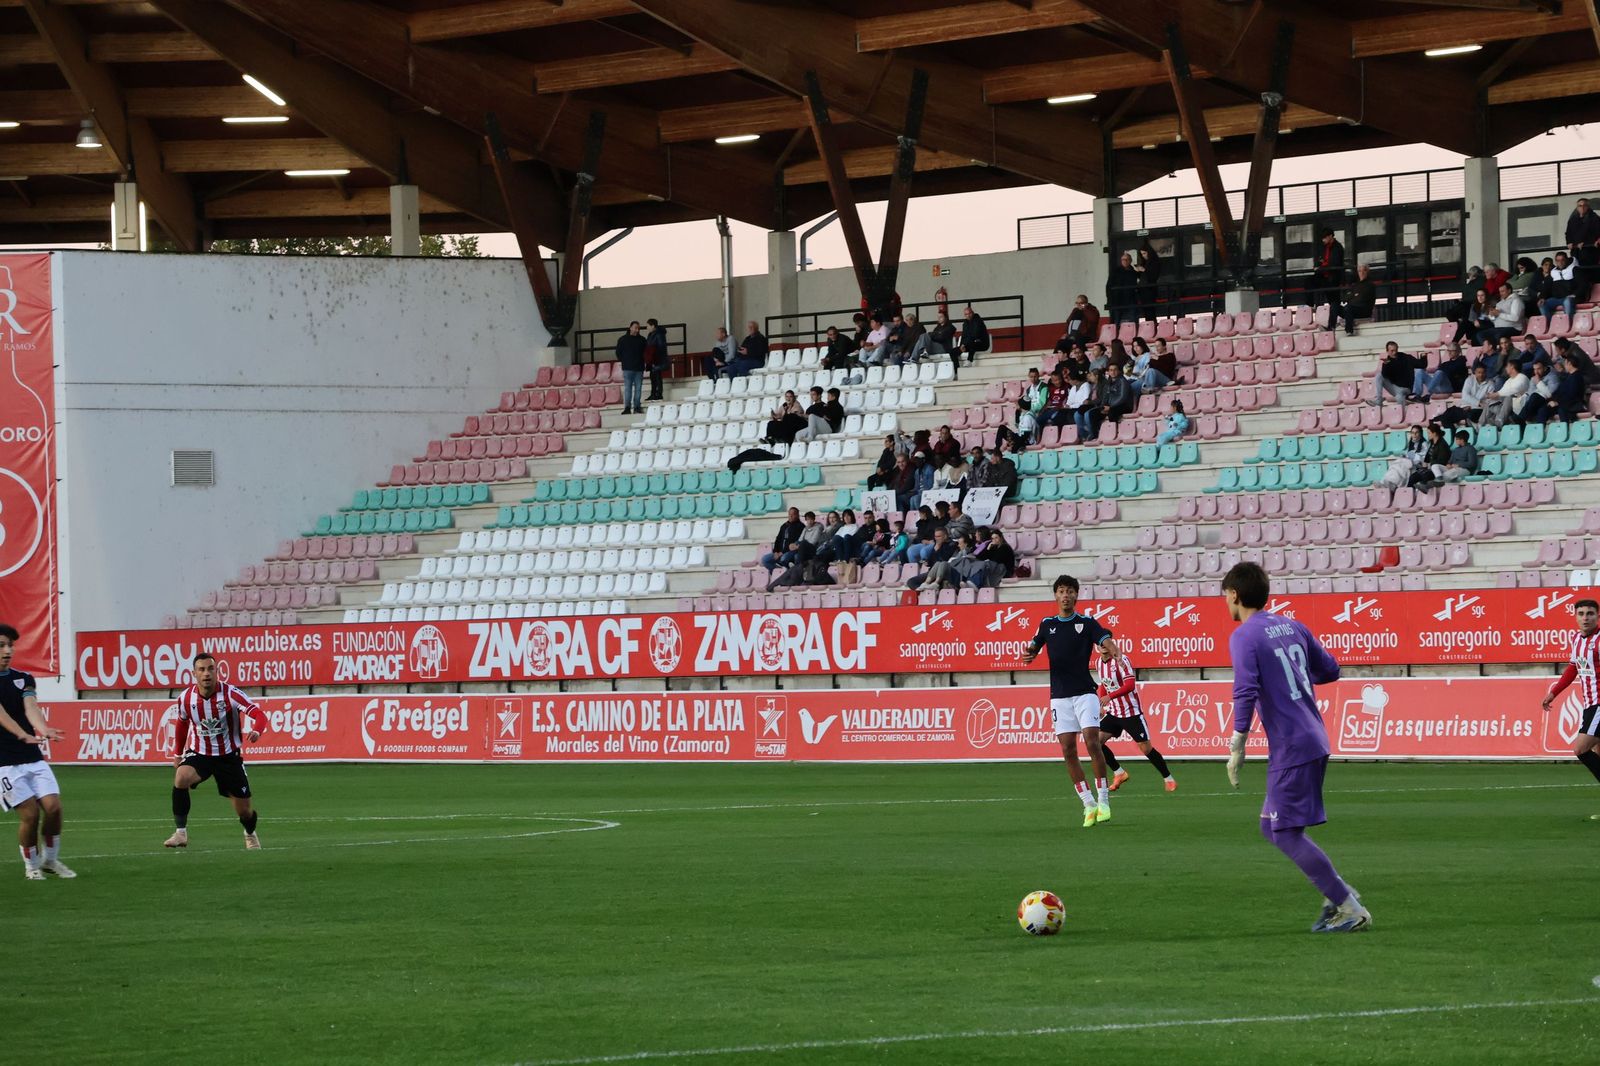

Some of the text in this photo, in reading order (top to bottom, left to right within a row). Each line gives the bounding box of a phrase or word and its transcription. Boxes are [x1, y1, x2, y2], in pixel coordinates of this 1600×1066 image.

[4, 343, 36, 351] RAMOS
[1108, 614, 1119, 627] sgc
[1188, 612, 1200, 625] sgc
[1370, 607, 1383, 620] sgc
[1472, 604, 1485, 618] sgc
[1565, 603, 1576, 616] sg
[942, 619, 954, 631] sgc
[1018, 616, 1029, 629] sgc
[1265, 623, 1294, 639] SANTOS
[202, 630, 322, 653] www.cubiex.es
[333, 625, 406, 653] FUNDACIÓN
[468, 617, 643, 678] ZAMORA CF
[694, 610, 881, 672] ZAMORA CF
[900, 638, 966, 662] sangregorio
[1141, 633, 1214, 657] sangregorio
[1319, 628, 1398, 654] sangregorio
[1419, 626, 1501, 652] sangregorio
[79, 634, 197, 688] cubiex
[237, 659, 312, 682] 675 630 110
[79, 704, 154, 731] FUNDACIÓN
[381, 699, 469, 739] Freigel
[532, 699, 745, 733] E.S. CAMINO DE LA PLATA
[841, 708, 955, 730] VALDERADUEY
[998, 706, 1049, 730] ELOY
[1343, 714, 1379, 738] Susi
[878, 734, 915, 742] COMERCIAL
[916, 733, 926, 741] DE
[927, 733, 955, 741] ZAMORA
[1385, 714, 1532, 742] casqueriasusi.es
[245, 746, 274, 754] GOODLIFE
[296, 745, 326, 753] COMPANY
[437, 745, 468, 753] COMPANY
[546, 734, 730, 755] Morales del Vino (Zamora)
[1198, 737, 1209, 747] DE
